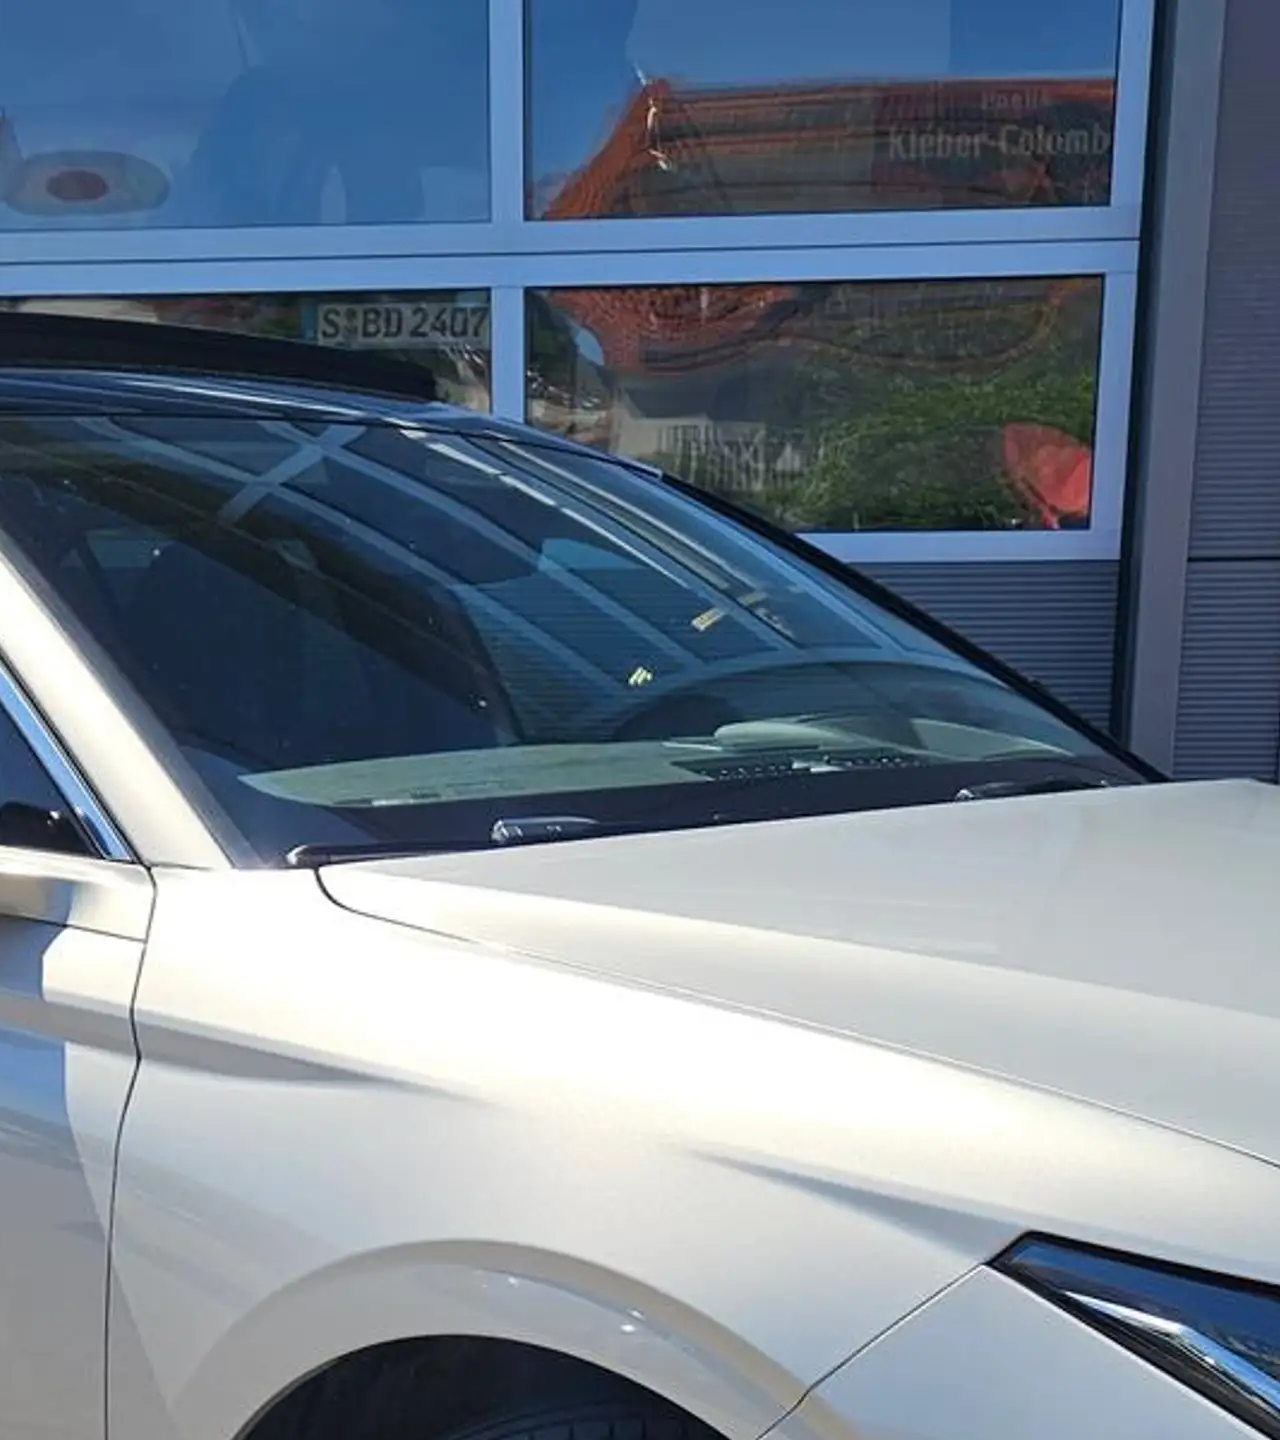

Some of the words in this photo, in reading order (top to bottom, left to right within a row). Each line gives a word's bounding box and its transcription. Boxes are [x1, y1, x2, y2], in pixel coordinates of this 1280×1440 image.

[321, 306, 341, 338] S
[362, 306, 404, 338] BD
[409, 305, 490, 338] 2407
